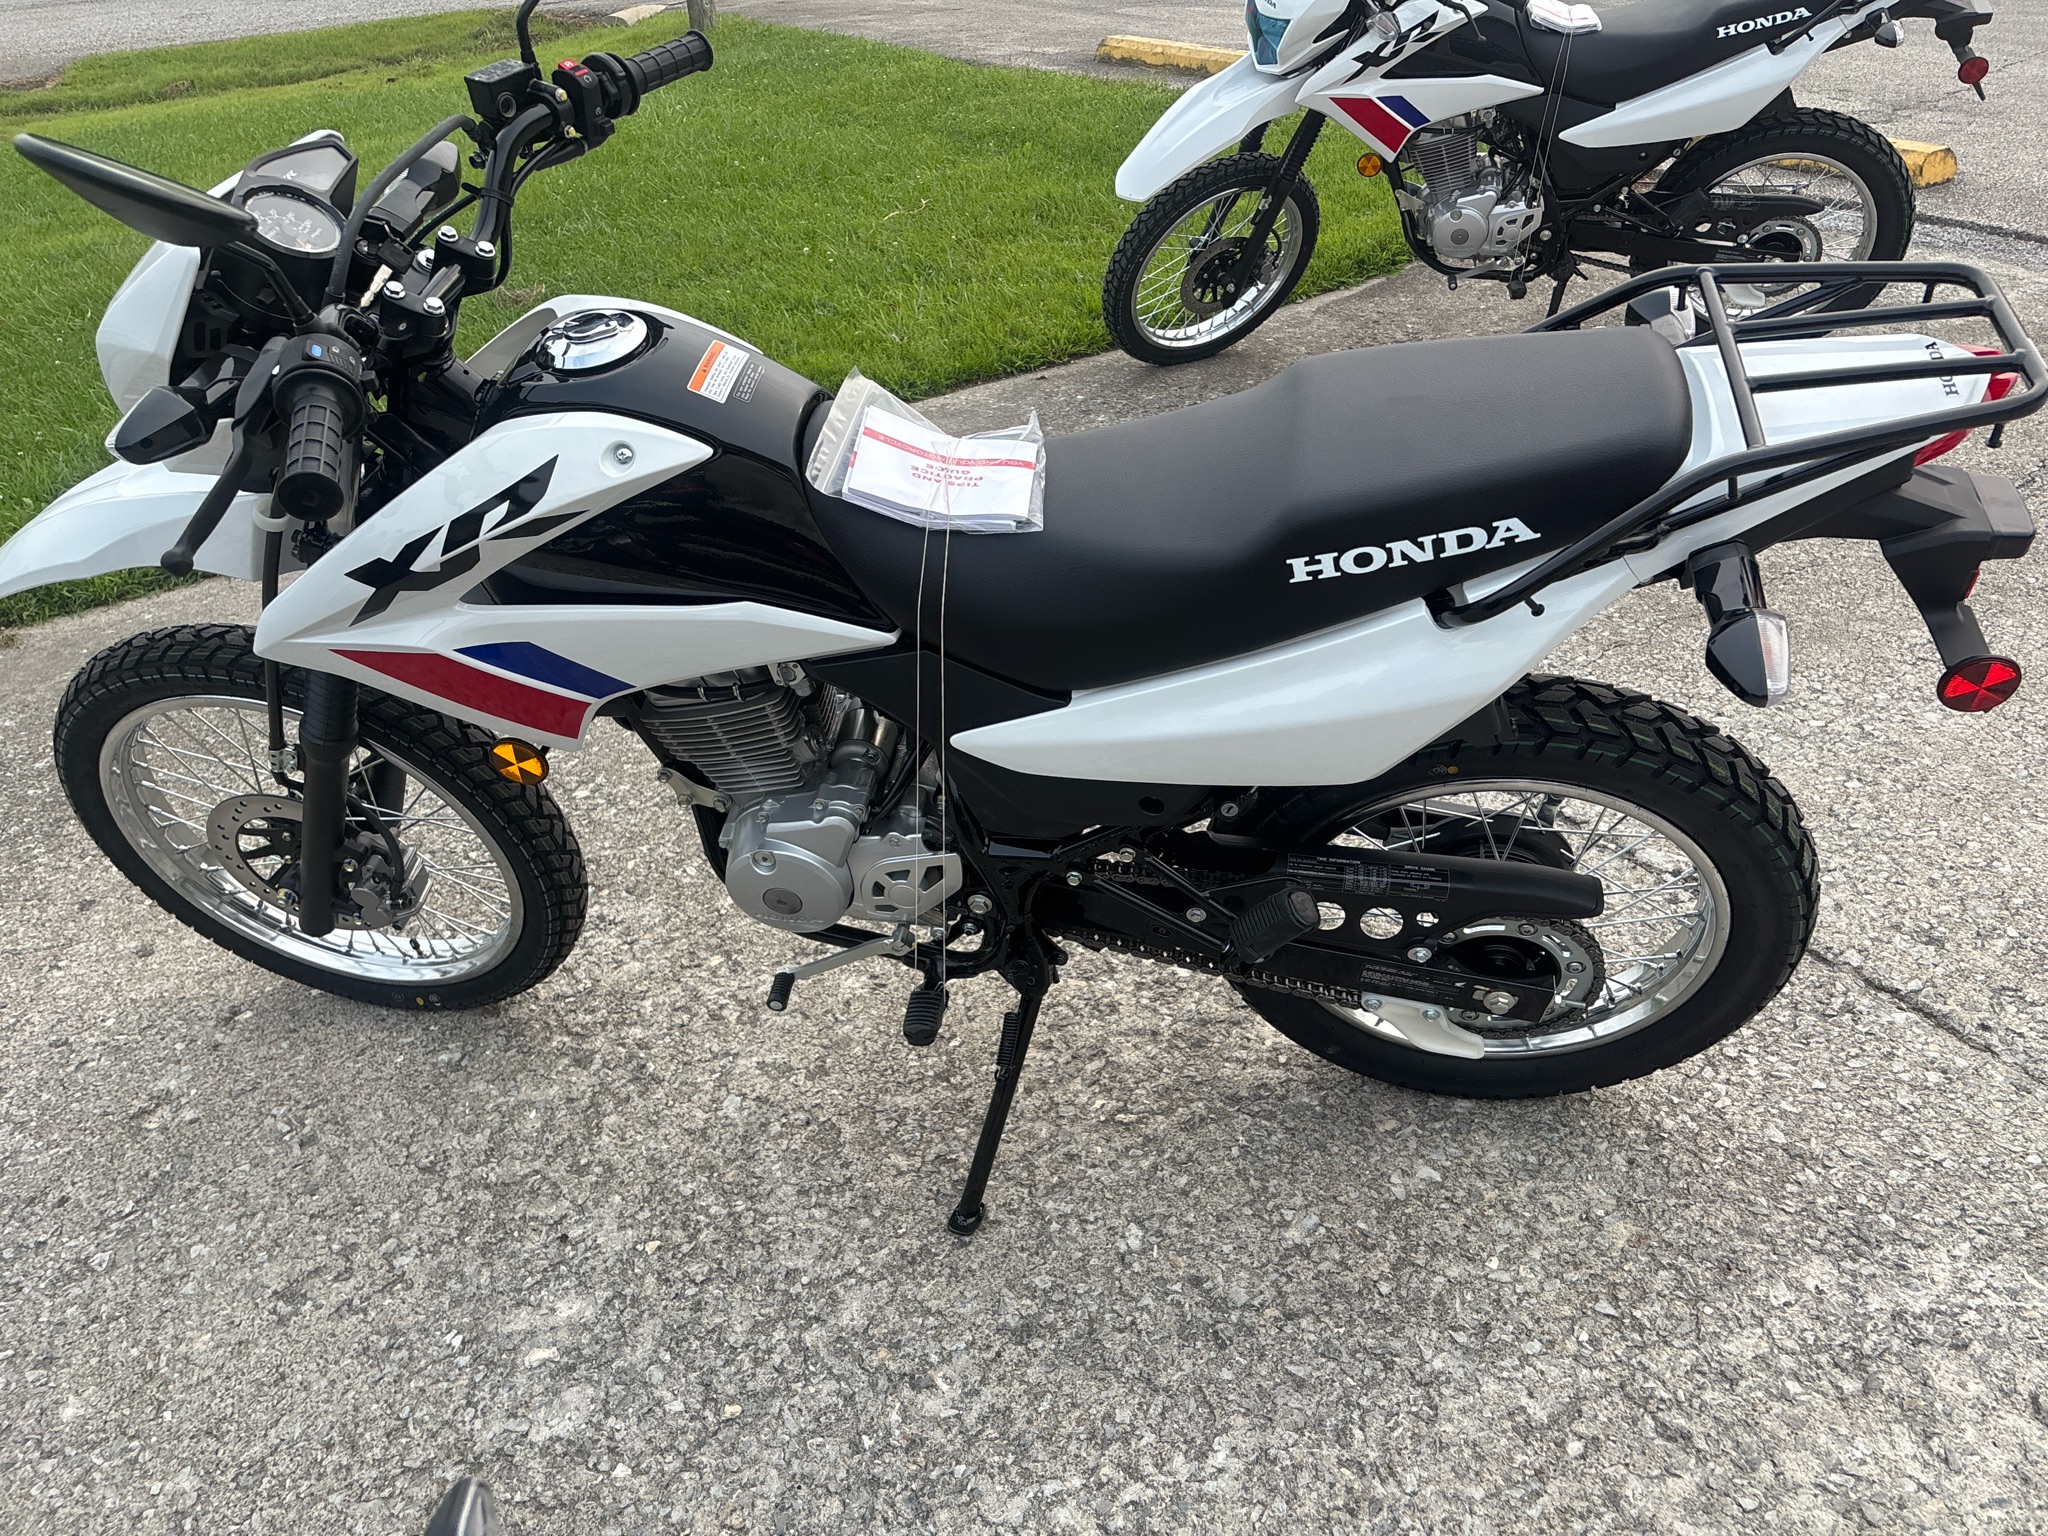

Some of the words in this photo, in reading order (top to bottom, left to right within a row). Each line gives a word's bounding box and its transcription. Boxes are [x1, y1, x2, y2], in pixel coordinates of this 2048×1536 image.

[1716, 7, 1812, 38] HONDA
[911, 472, 942, 484] AND
[1286, 517, 1541, 584] HONDA
